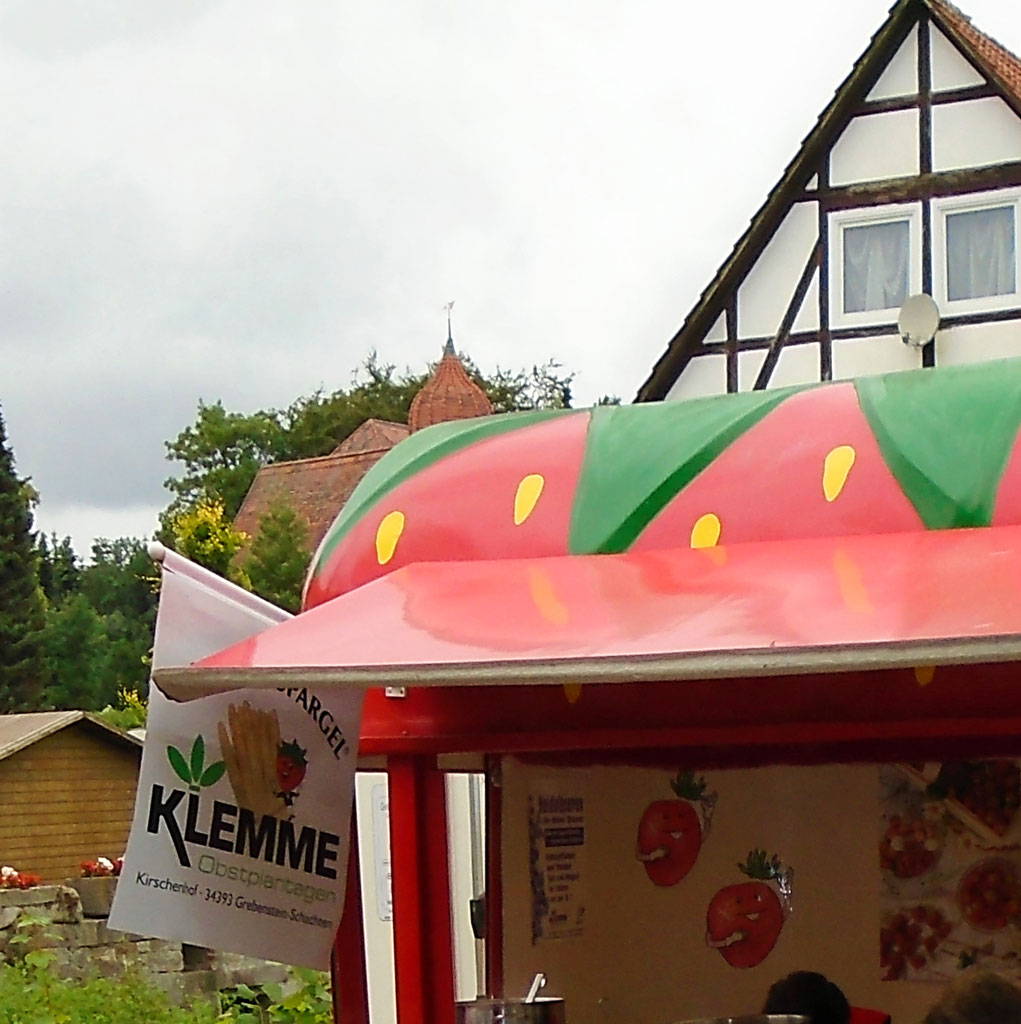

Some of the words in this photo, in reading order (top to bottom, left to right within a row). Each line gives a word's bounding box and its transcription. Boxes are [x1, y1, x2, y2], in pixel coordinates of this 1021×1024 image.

[277, 687, 346, 761] ARGEL
[147, 784, 341, 880] KLEMME
[136, 871, 198, 897] Kirschenhof
[204, 889, 233, 907] 34393
[197, 854, 336, 905] Obstplantagen
